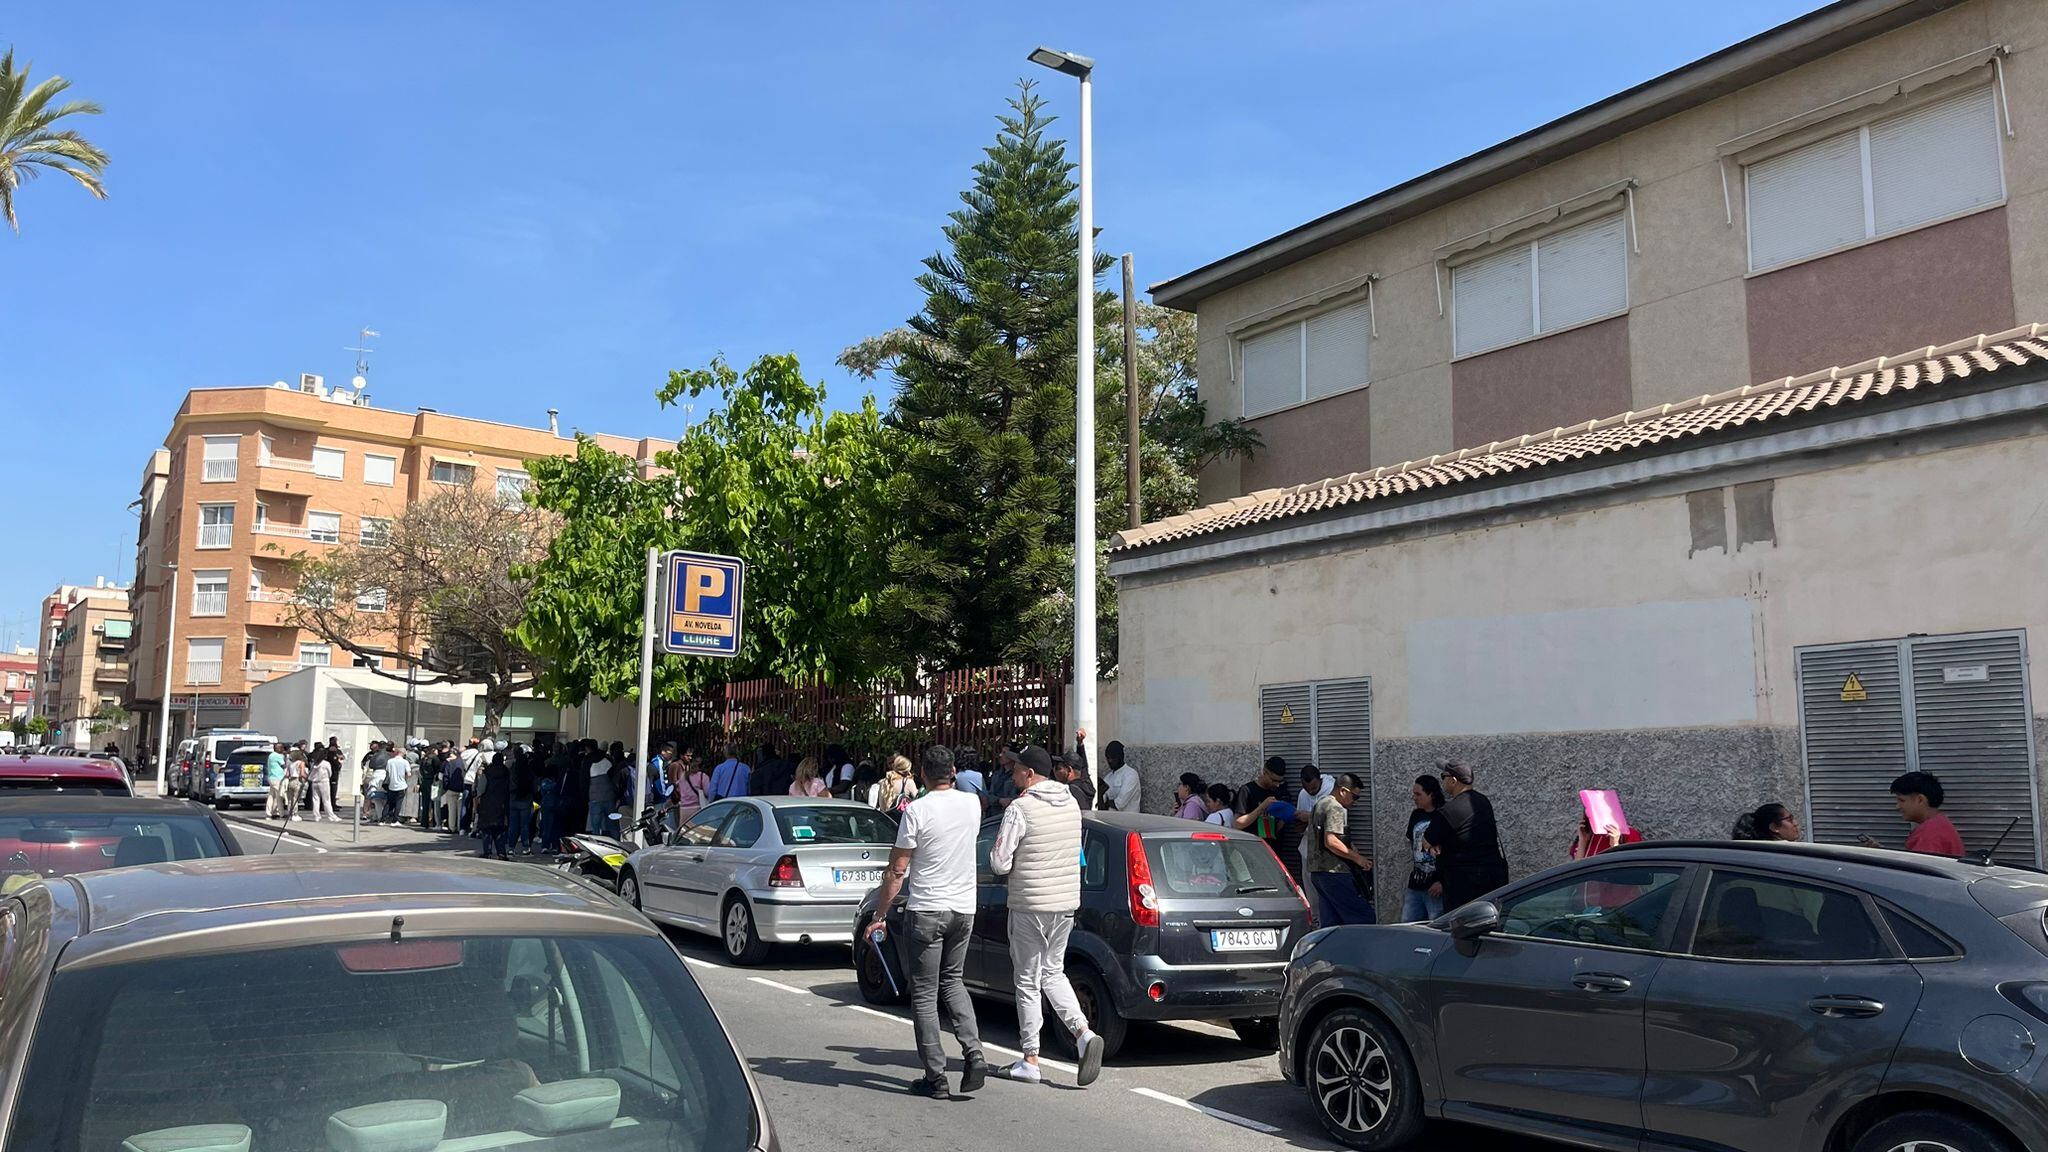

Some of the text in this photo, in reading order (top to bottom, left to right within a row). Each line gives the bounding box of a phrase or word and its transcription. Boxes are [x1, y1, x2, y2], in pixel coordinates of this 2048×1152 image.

[684, 564, 725, 612] P
[684, 620, 722, 630] AV. NOVELDA
[683, 634, 720, 646] LLIURE
[229, 697, 246, 705] XIN
[841, 871, 866, 881] 6738
[1219, 931, 1274, 946] 7843 GCJ
